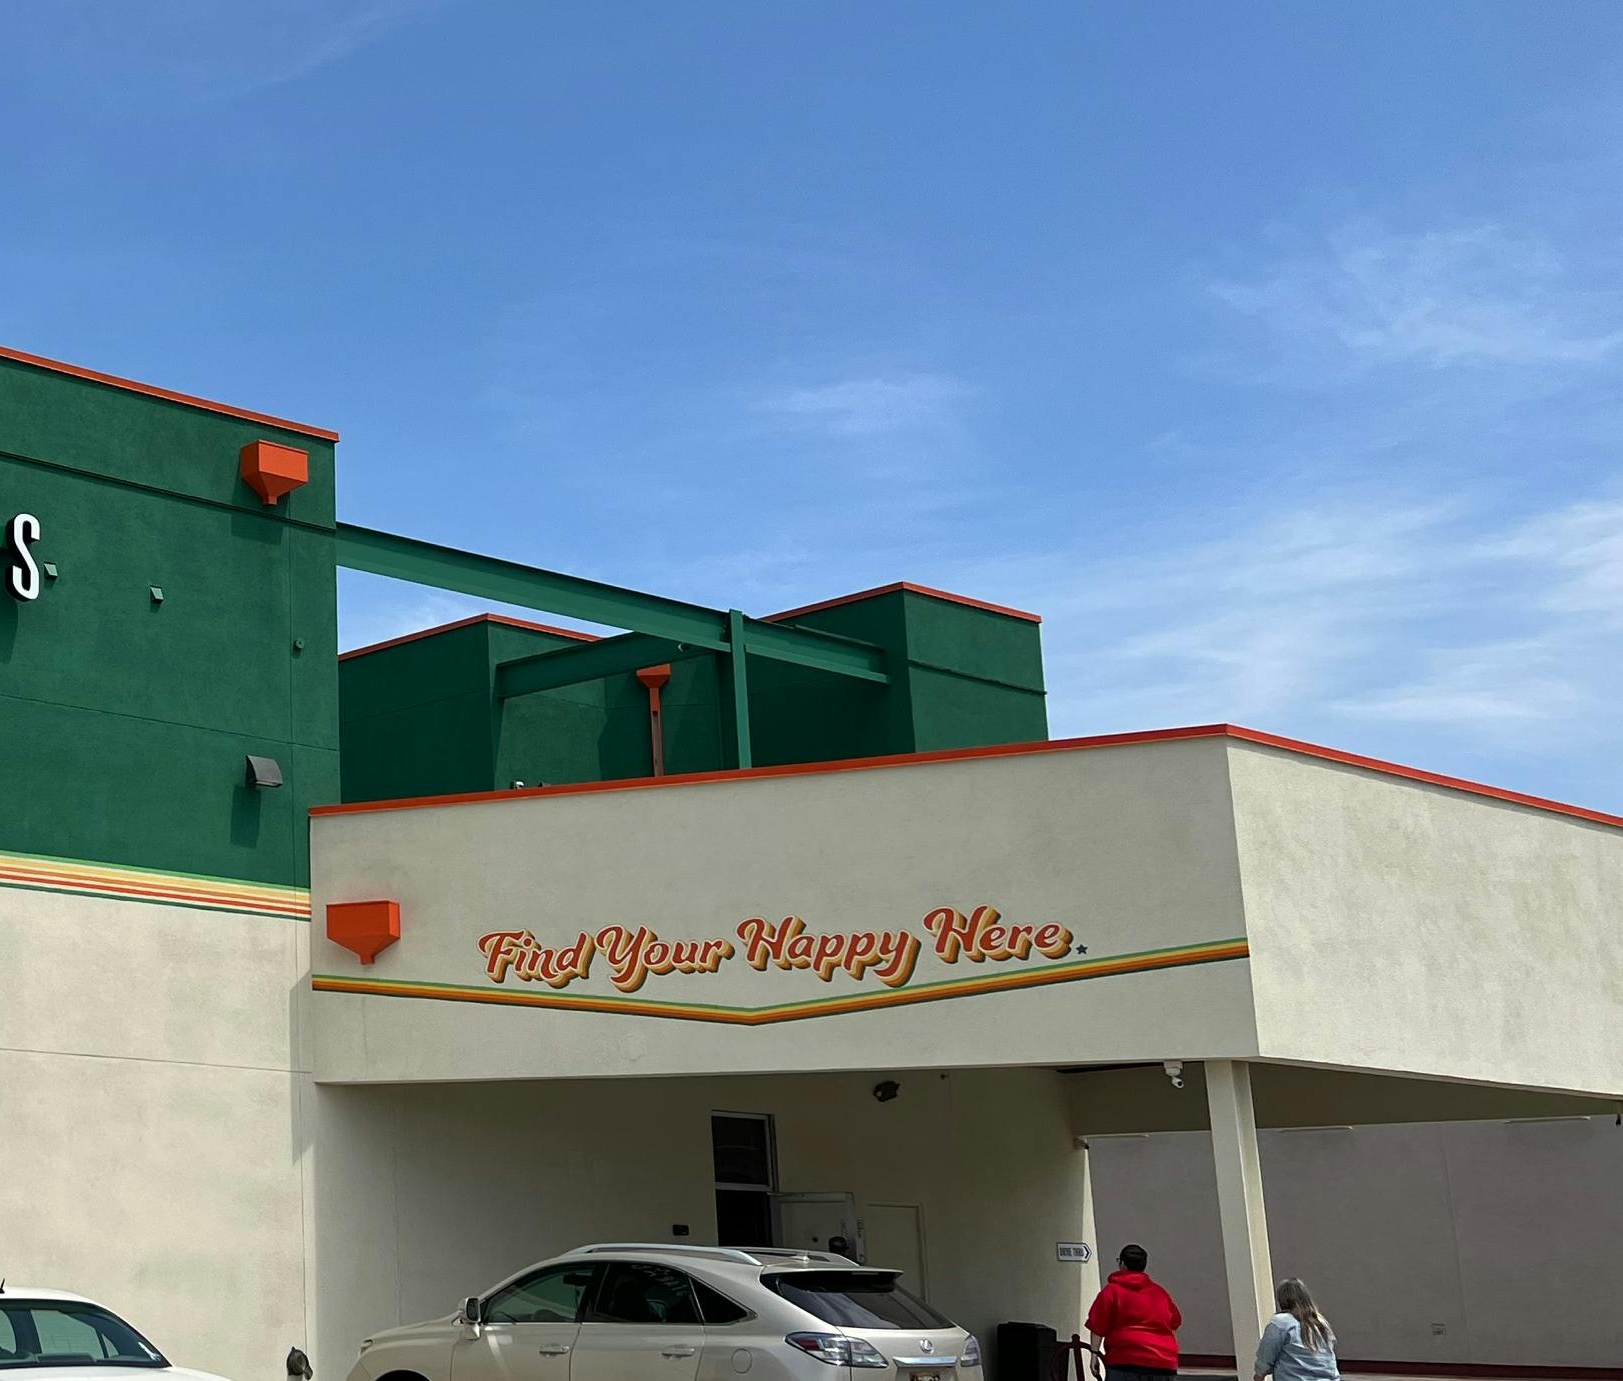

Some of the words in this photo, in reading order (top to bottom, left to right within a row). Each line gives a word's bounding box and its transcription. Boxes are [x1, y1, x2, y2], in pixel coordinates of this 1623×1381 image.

[478, 928, 596, 989] Find
[594, 923, 735, 993] Your
[735, 915, 922, 988] Happy
[923, 904, 1075, 964] Here
